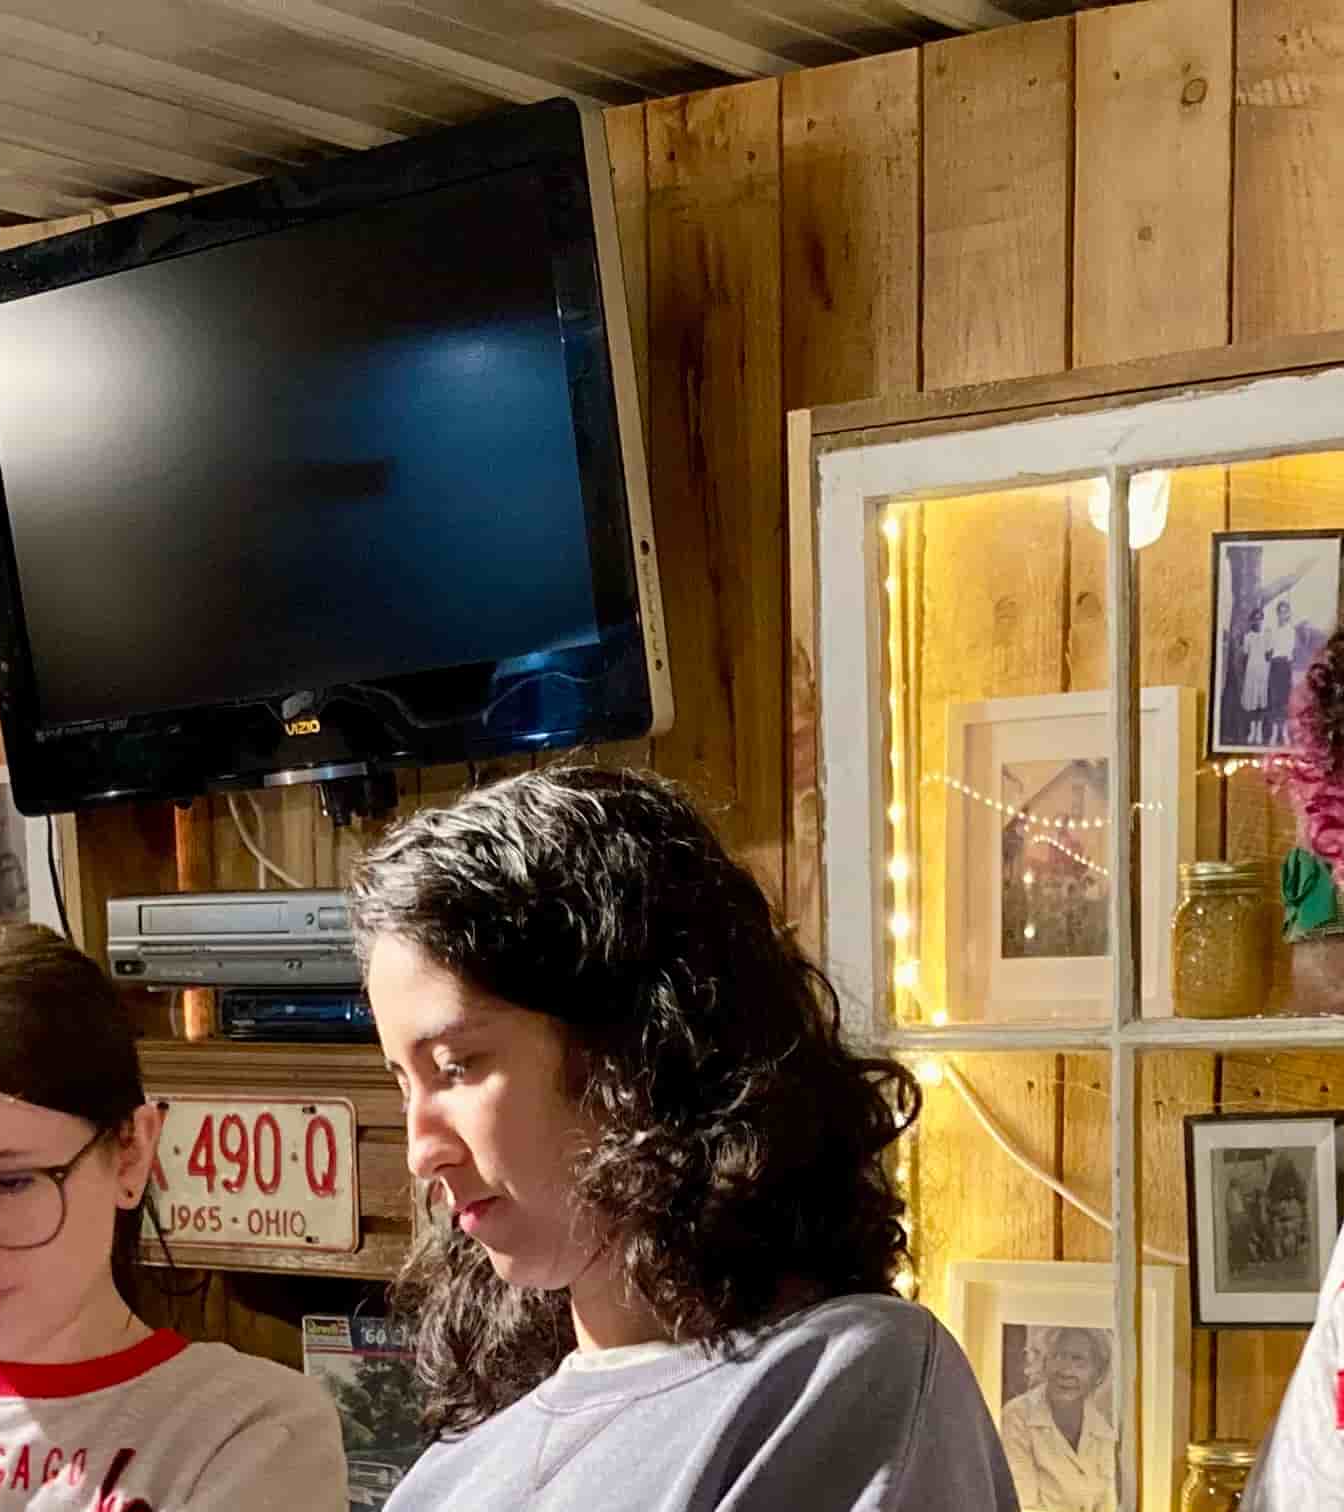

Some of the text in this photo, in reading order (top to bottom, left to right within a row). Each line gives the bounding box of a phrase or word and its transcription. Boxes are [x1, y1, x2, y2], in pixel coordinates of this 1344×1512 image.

[284, 719, 321, 737] VIZIO
[164, 1203, 306, 1238] 1965 OHIO
